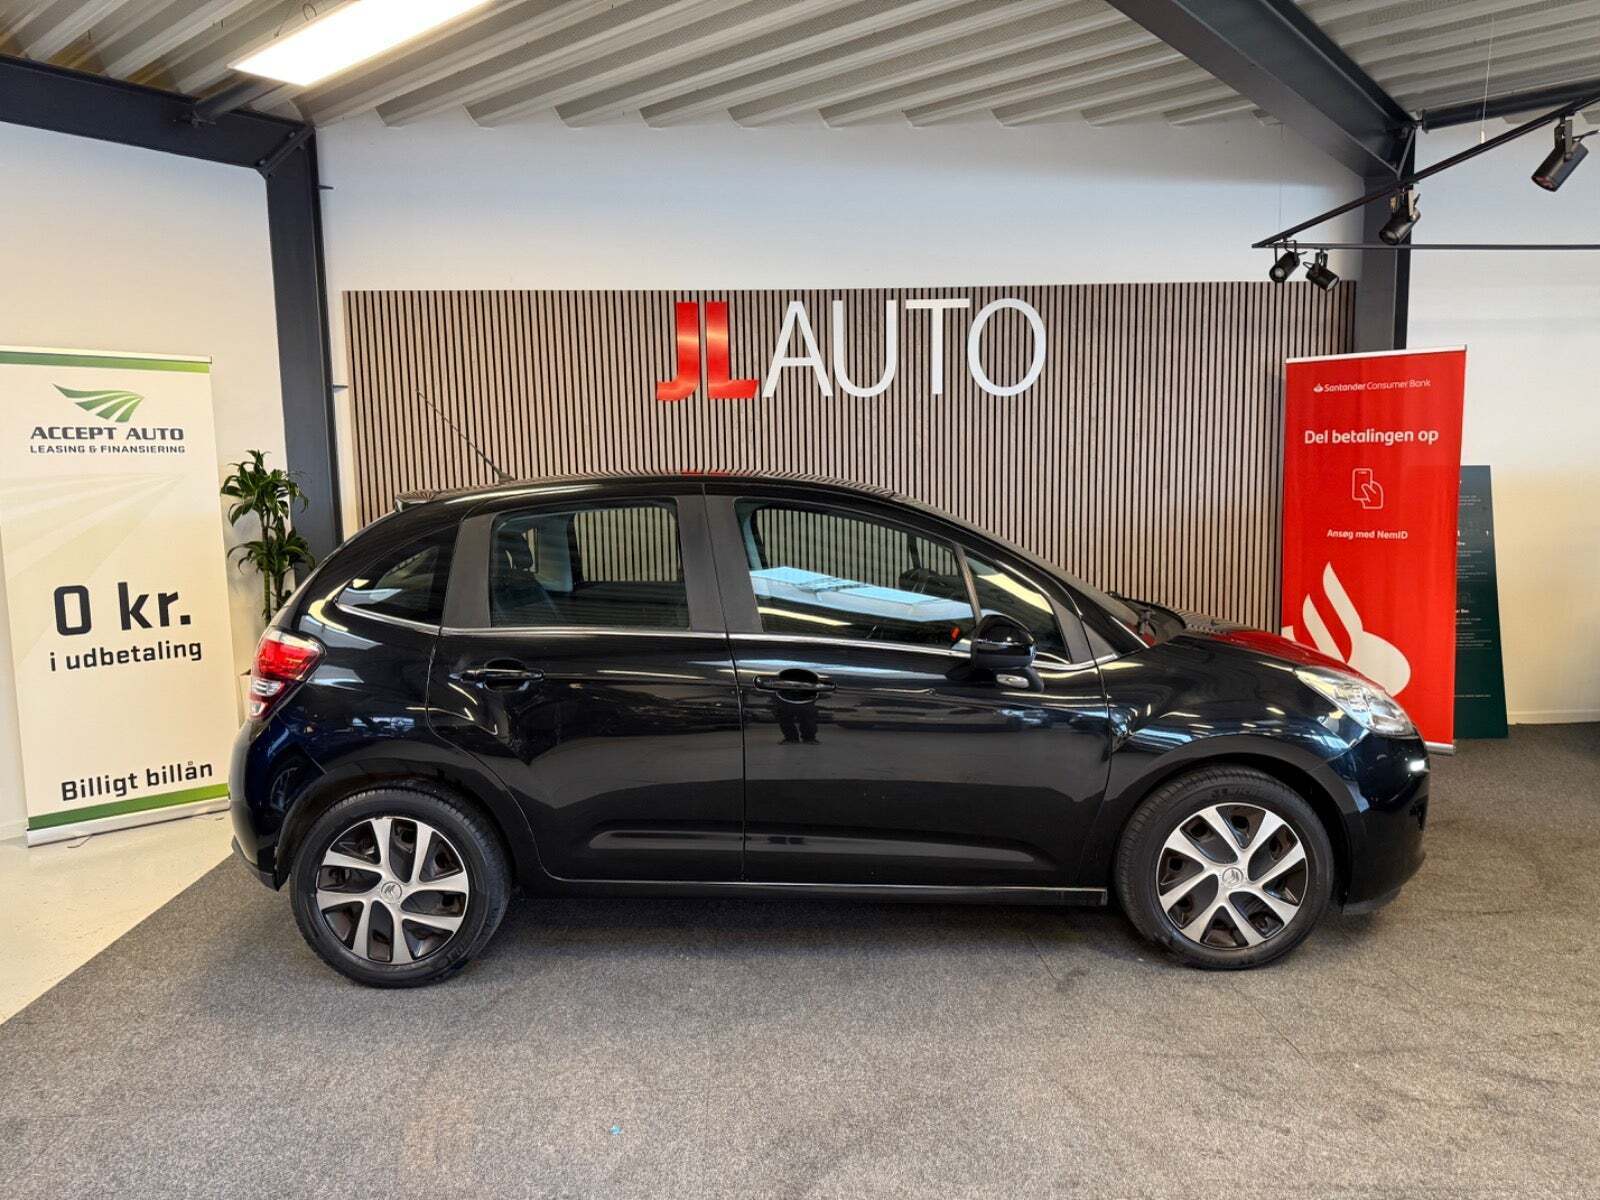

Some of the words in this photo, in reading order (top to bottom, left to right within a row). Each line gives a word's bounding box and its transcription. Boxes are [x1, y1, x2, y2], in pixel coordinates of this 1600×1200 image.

[656, 301, 760, 401] JL
[762, 298, 1047, 398] AUTO
[1324, 383, 1366, 392] Santander
[1366, 380, 1408, 391] Consumer
[1409, 379, 1431, 388] Bank
[31, 426, 117, 440] ACCEPT
[126, 427, 184, 440] AUTO
[1304, 430, 1329, 444] Del
[1332, 428, 1414, 446] betalingen
[1418, 430, 1439, 445] op
[30, 445, 85, 453] LEASING
[89, 445, 97, 453] &
[101, 445, 185, 453] FINANSIERING
[1327, 529, 1354, 540] Ansøg
[1355, 530, 1375, 539] med
[1377, 530, 1408, 540] NemID
[54, 585, 92, 636] 0
[117, 581, 191, 631] kr.
[50, 652, 56, 672] i
[66, 641, 202, 670] udbetaling
[61, 773, 138, 801] Billigt
[146, 761, 213, 787] billån
